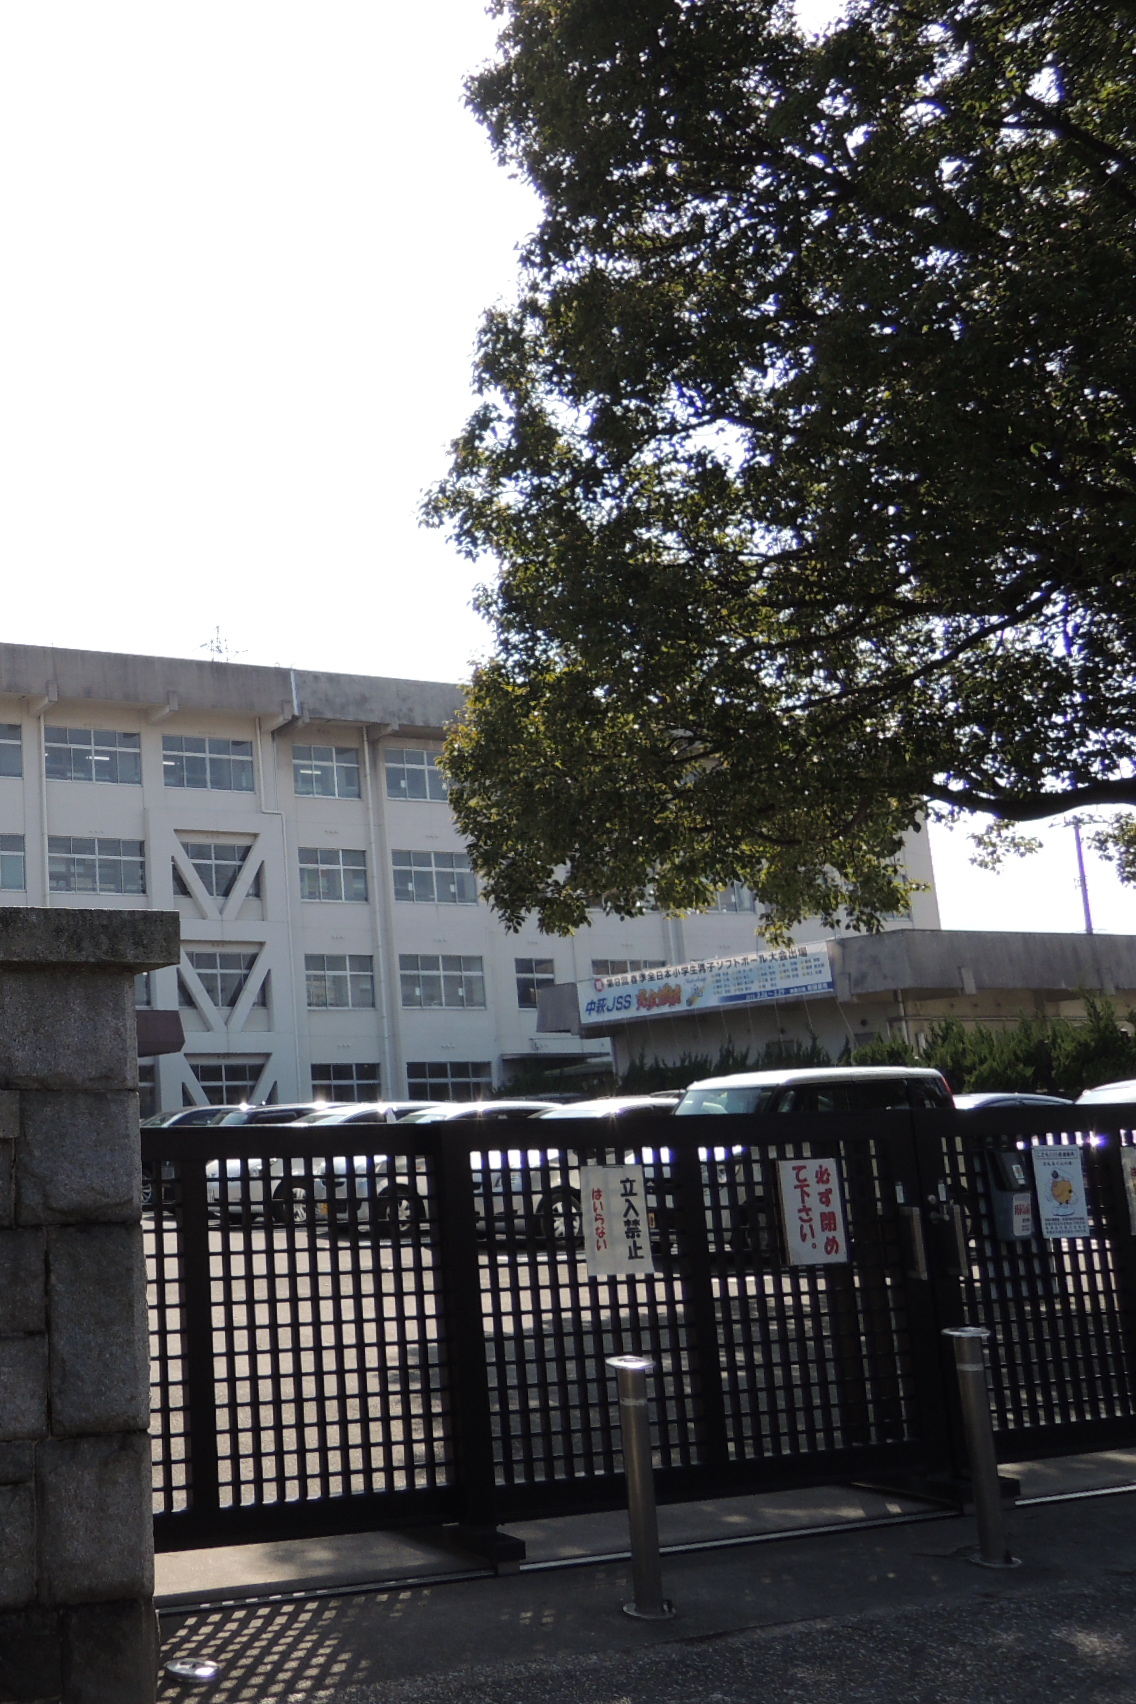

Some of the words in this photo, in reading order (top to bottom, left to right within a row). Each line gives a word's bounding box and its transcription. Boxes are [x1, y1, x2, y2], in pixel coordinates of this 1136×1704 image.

[591, 1188, 608, 1251] はいらない
[620, 1177, 645, 1260] 立入禁止
[815, 1164, 840, 1255] 必ず閉め
